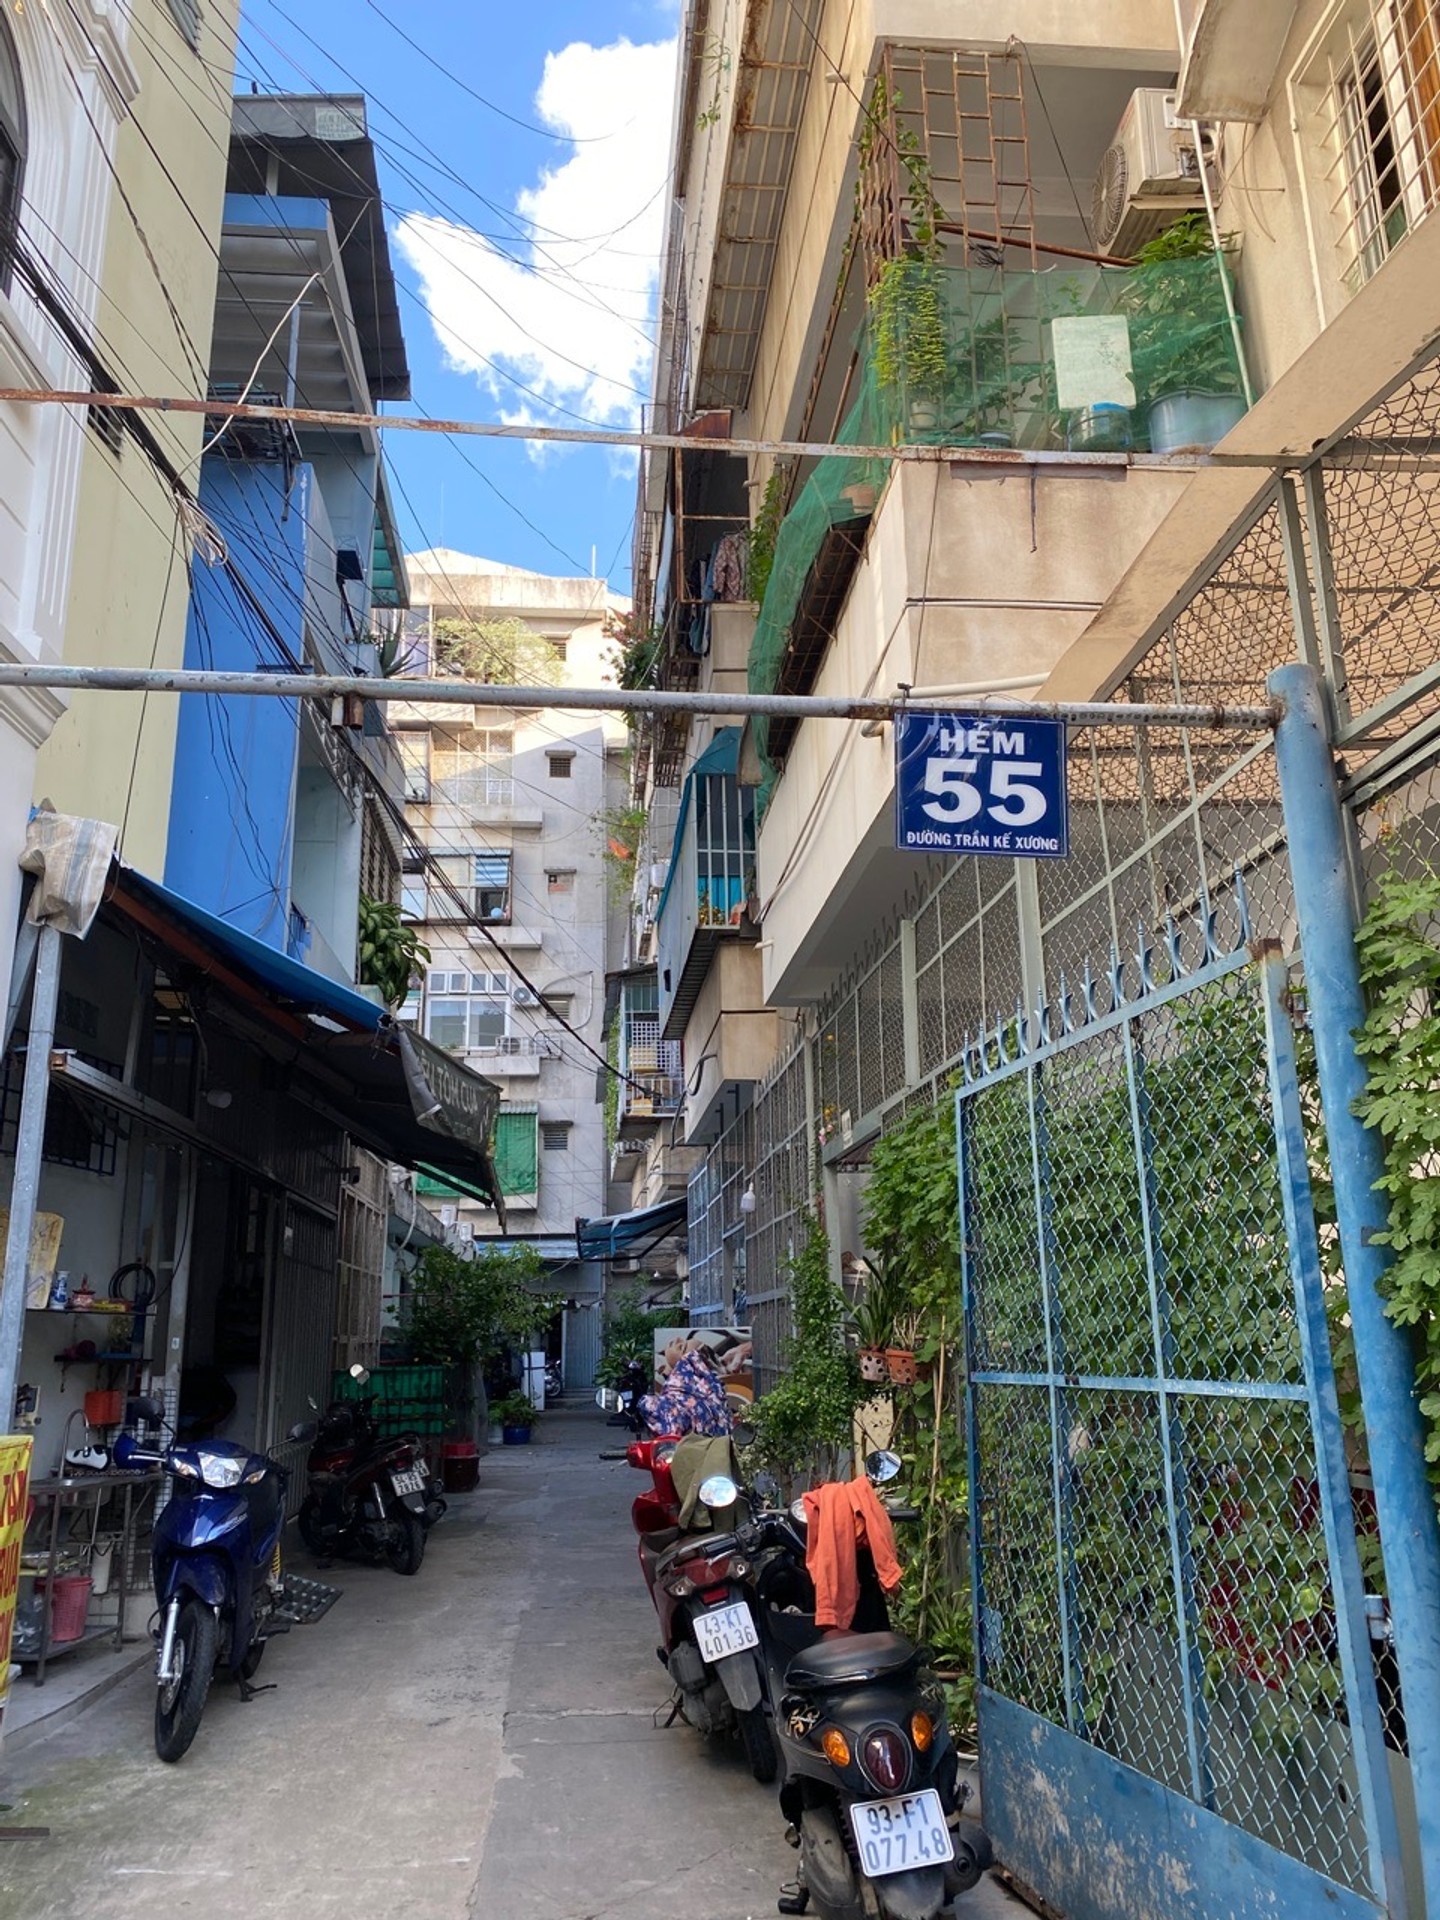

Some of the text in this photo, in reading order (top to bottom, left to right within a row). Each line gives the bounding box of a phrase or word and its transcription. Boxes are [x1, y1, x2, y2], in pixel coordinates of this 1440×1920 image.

[921, 757, 1047, 827] 55
[906, 829, 1059, 850] ĐƯỜNG TRẦN KẾ XƯƠNG
[703, 1609, 742, 1636] 43-K1
[705, 1625, 755, 1657] 401.36
[867, 1797, 929, 1835] 93-F1
[865, 1827, 947, 1870] 077.48
